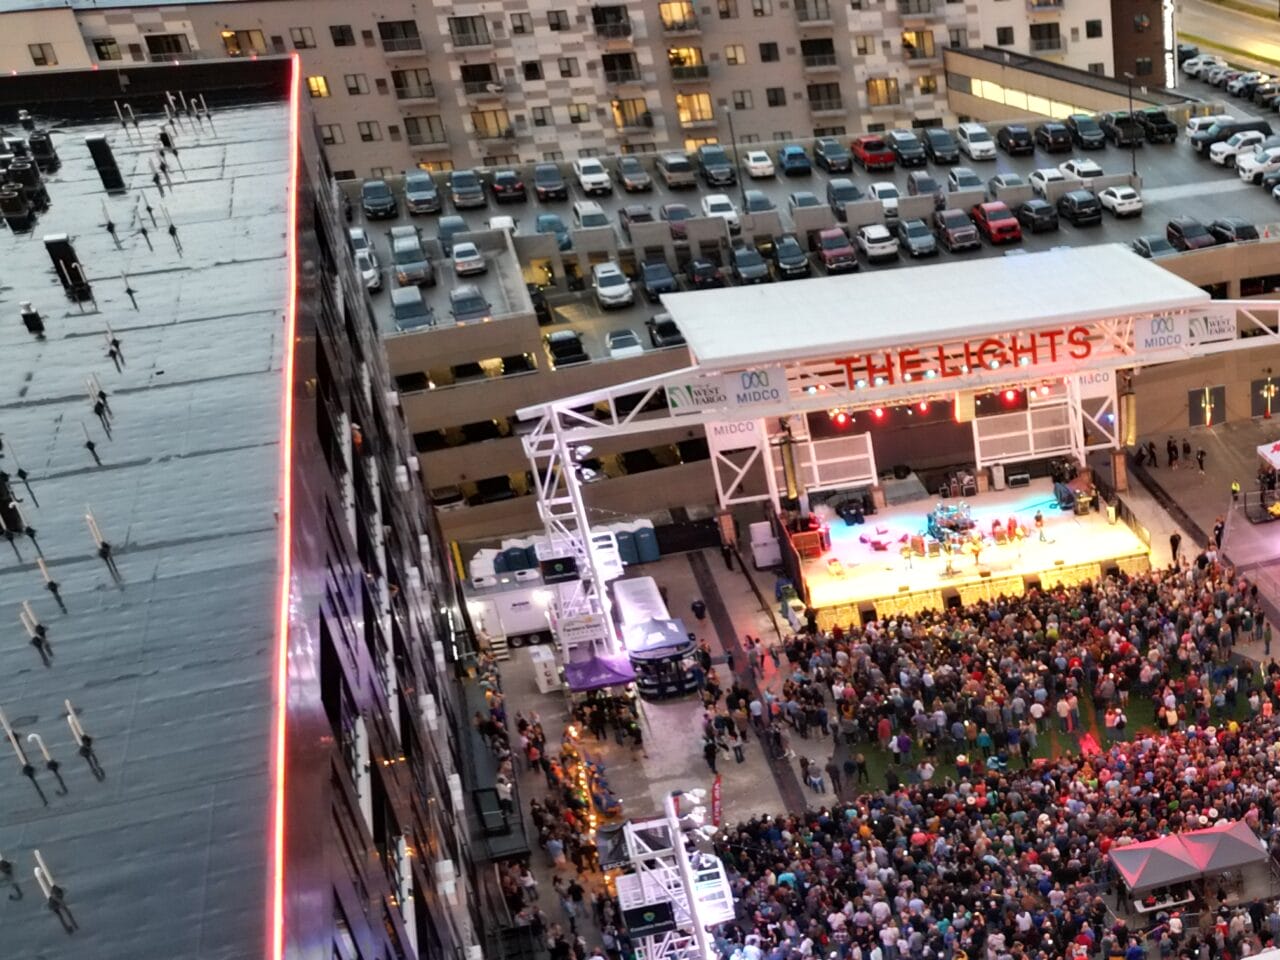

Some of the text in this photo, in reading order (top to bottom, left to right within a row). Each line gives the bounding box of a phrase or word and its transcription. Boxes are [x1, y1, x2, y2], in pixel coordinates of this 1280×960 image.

[1208, 318, 1231, 328] WEST
[1208, 324, 1236, 336] FARGO
[1144, 333, 1181, 349] MIDCO
[835, 326, 1092, 391] THE LIGHTS
[692, 386, 720, 398] WEST
[694, 394, 727, 406] FARGO
[736, 387, 780, 406] MIDCO
[714, 421, 755, 437] MIDCO
[543, 661, 554, 687] ICE
